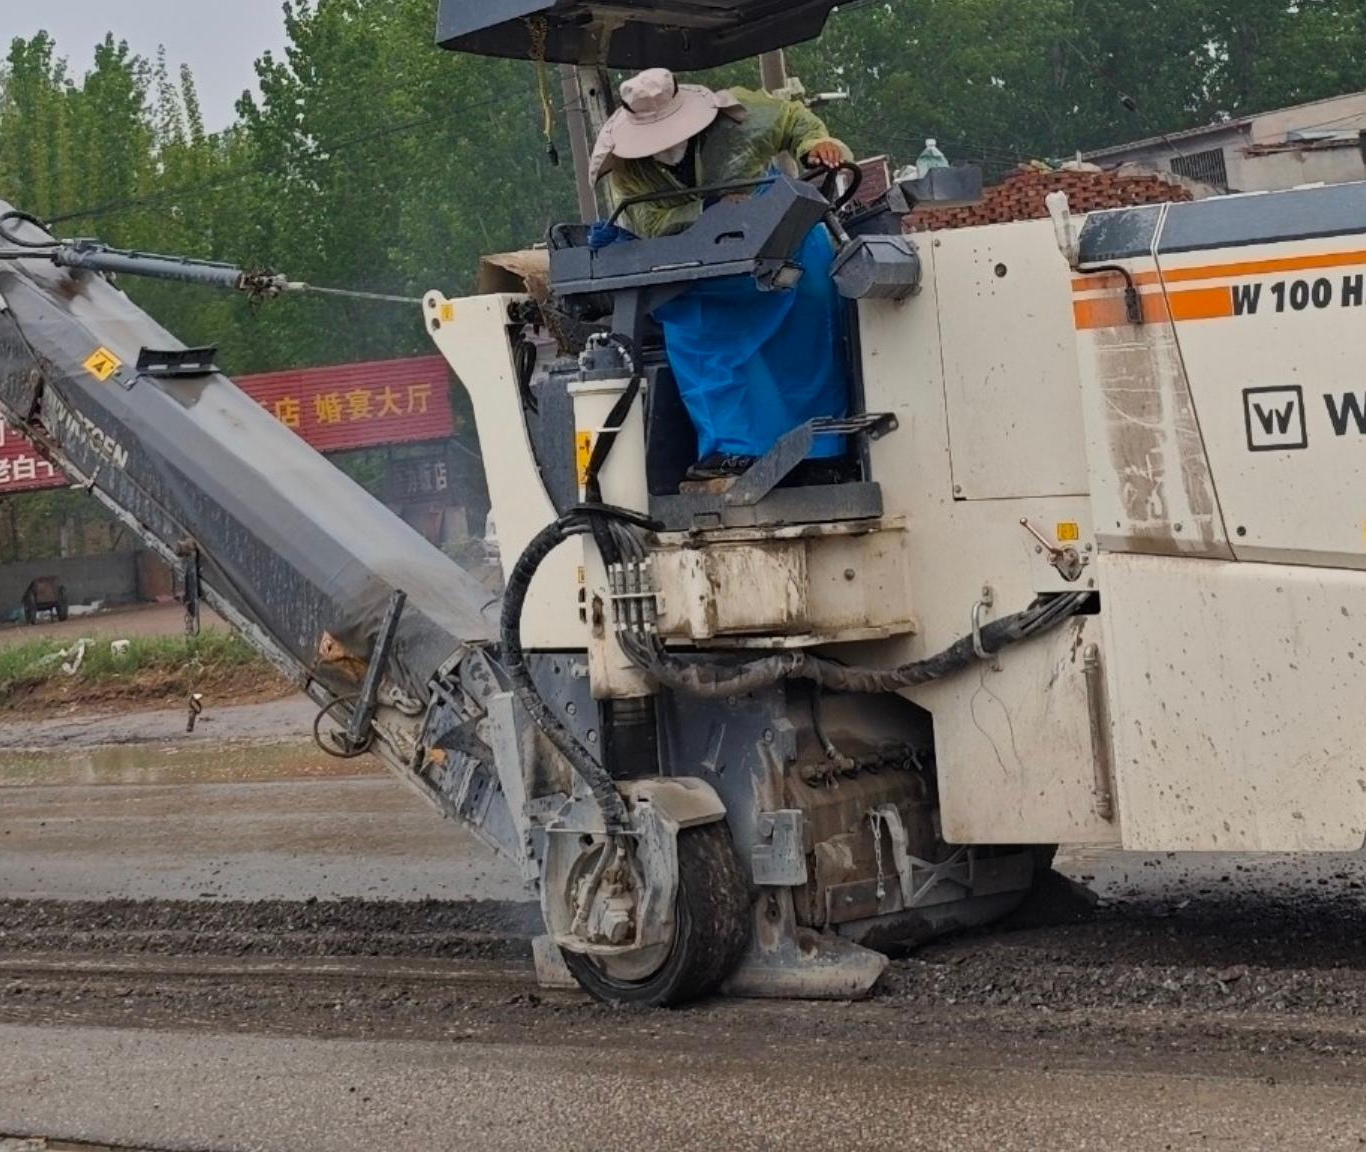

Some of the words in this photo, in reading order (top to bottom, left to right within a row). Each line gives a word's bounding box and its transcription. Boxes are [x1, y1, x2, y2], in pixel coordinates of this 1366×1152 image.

[1232, 283, 1262, 316] W
[1271, 277, 1332, 313] 100
[314, 383, 432, 425] 婚宴大厅
